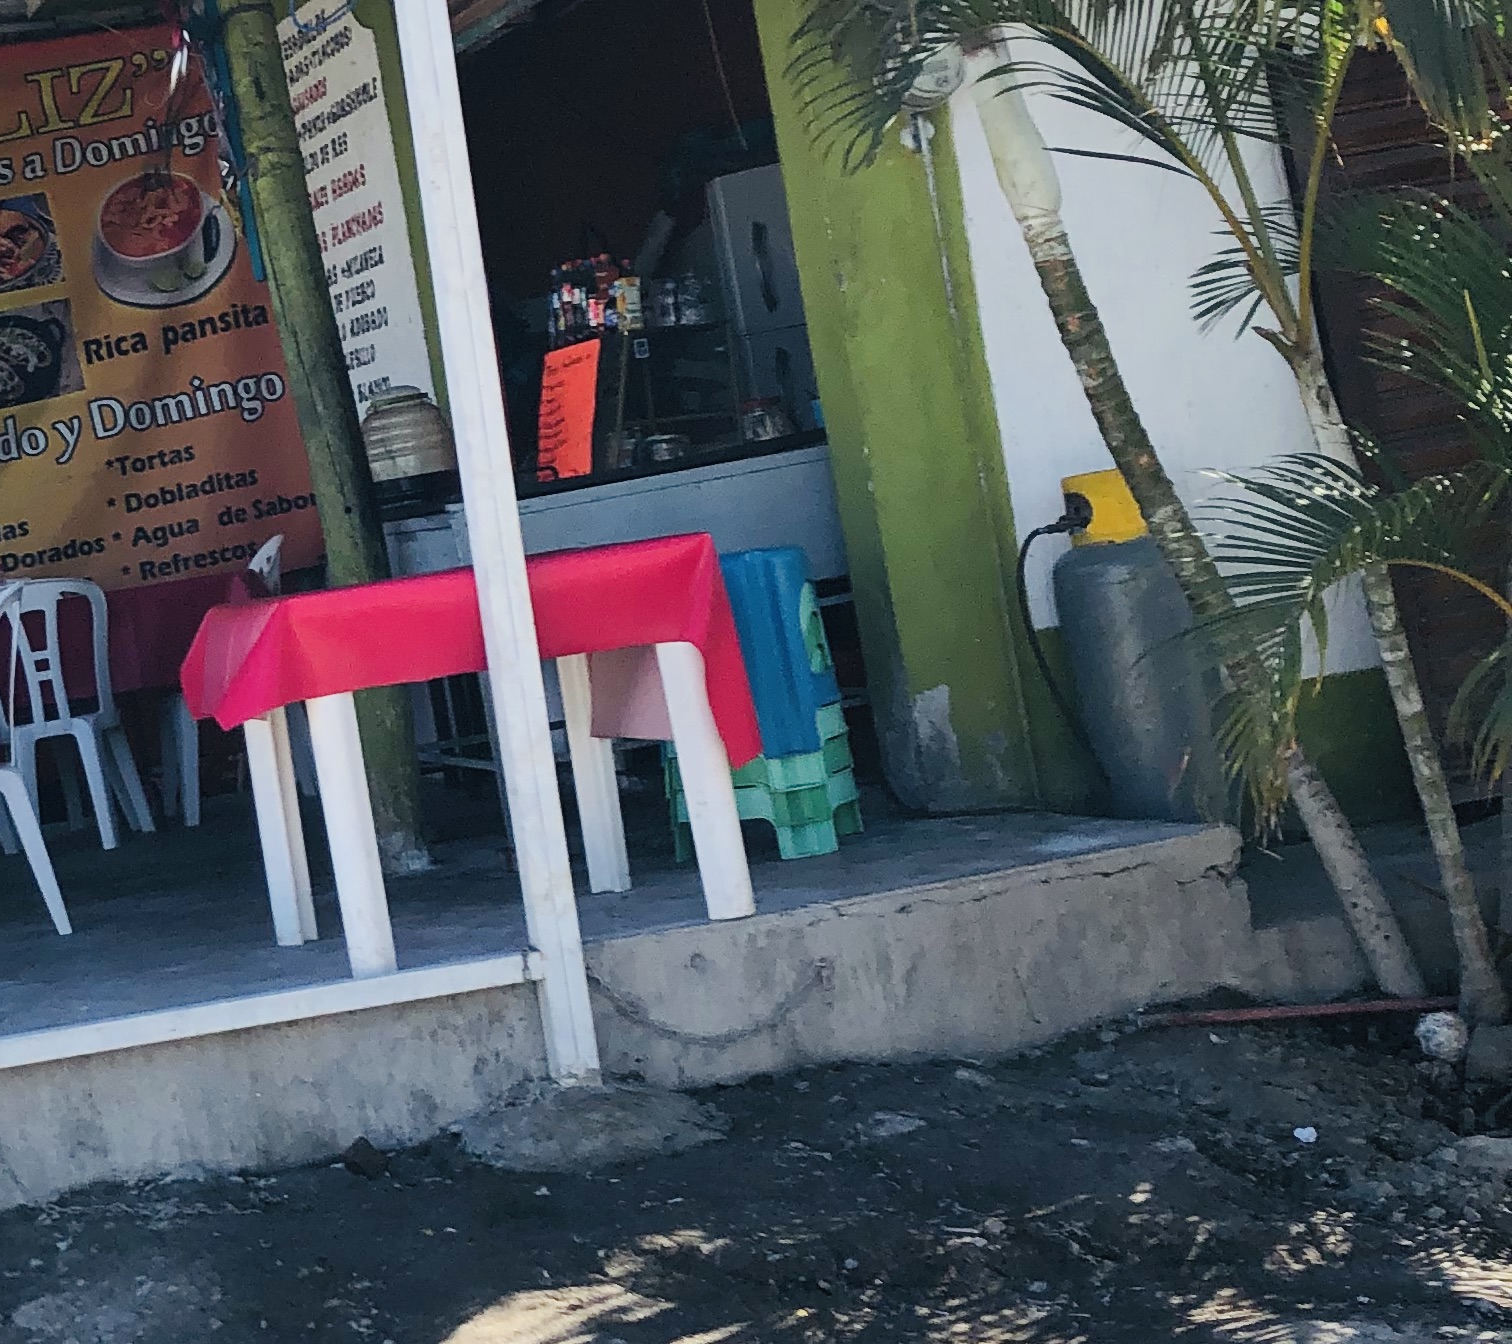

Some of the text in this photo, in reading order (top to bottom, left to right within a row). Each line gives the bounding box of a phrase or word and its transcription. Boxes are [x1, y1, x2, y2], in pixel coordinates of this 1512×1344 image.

[22, 157, 45, 180] a
[83, 303, 268, 365] Rica pansita
[55, 418, 83, 464] y
[89, 372, 284, 442] Domingo
[125, 467, 259, 513] Dobladitas
[132, 517, 199, 549] Agua
[218, 506, 248, 527] de
[0, 537, 105, 573] Dorados
[138, 539, 258, 581] Refrescos
